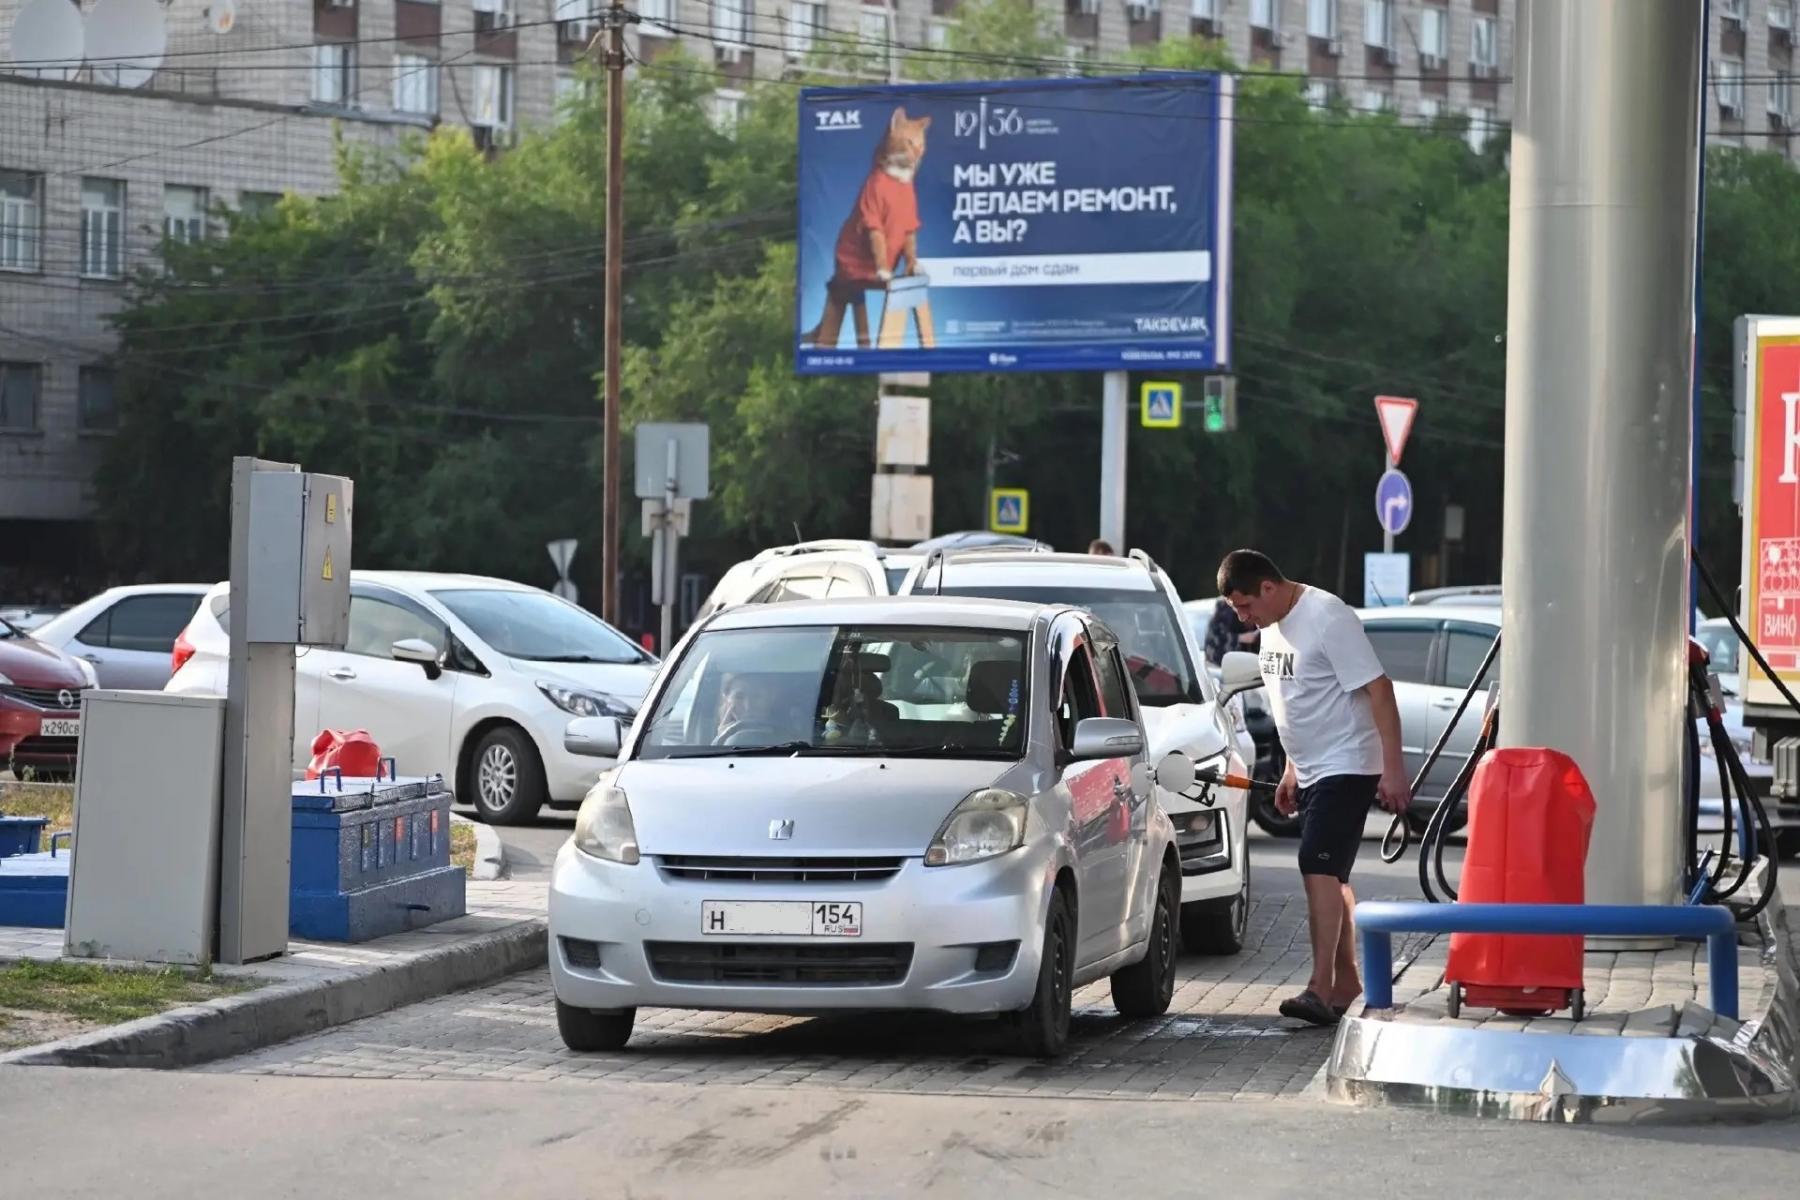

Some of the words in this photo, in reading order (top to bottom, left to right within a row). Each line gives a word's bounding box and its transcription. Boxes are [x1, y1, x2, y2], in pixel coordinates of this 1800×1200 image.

[953, 164, 996, 187] МЫ
[1000, 162, 1056, 186] УЖЕ
[952, 190, 1059, 220] ДЕЛАЕМ
[1063, 186, 1178, 214] РЕМОНТ,
[952, 220, 972, 244] А
[975, 218, 1028, 242] ВЫ?
[952, 262, 1007, 278] первый
[1010, 264, 1039, 277] дом
[1764, 613, 1797, 637] ВИНО
[815, 904, 854, 924] 154
[824, 925, 843, 933] RUS
